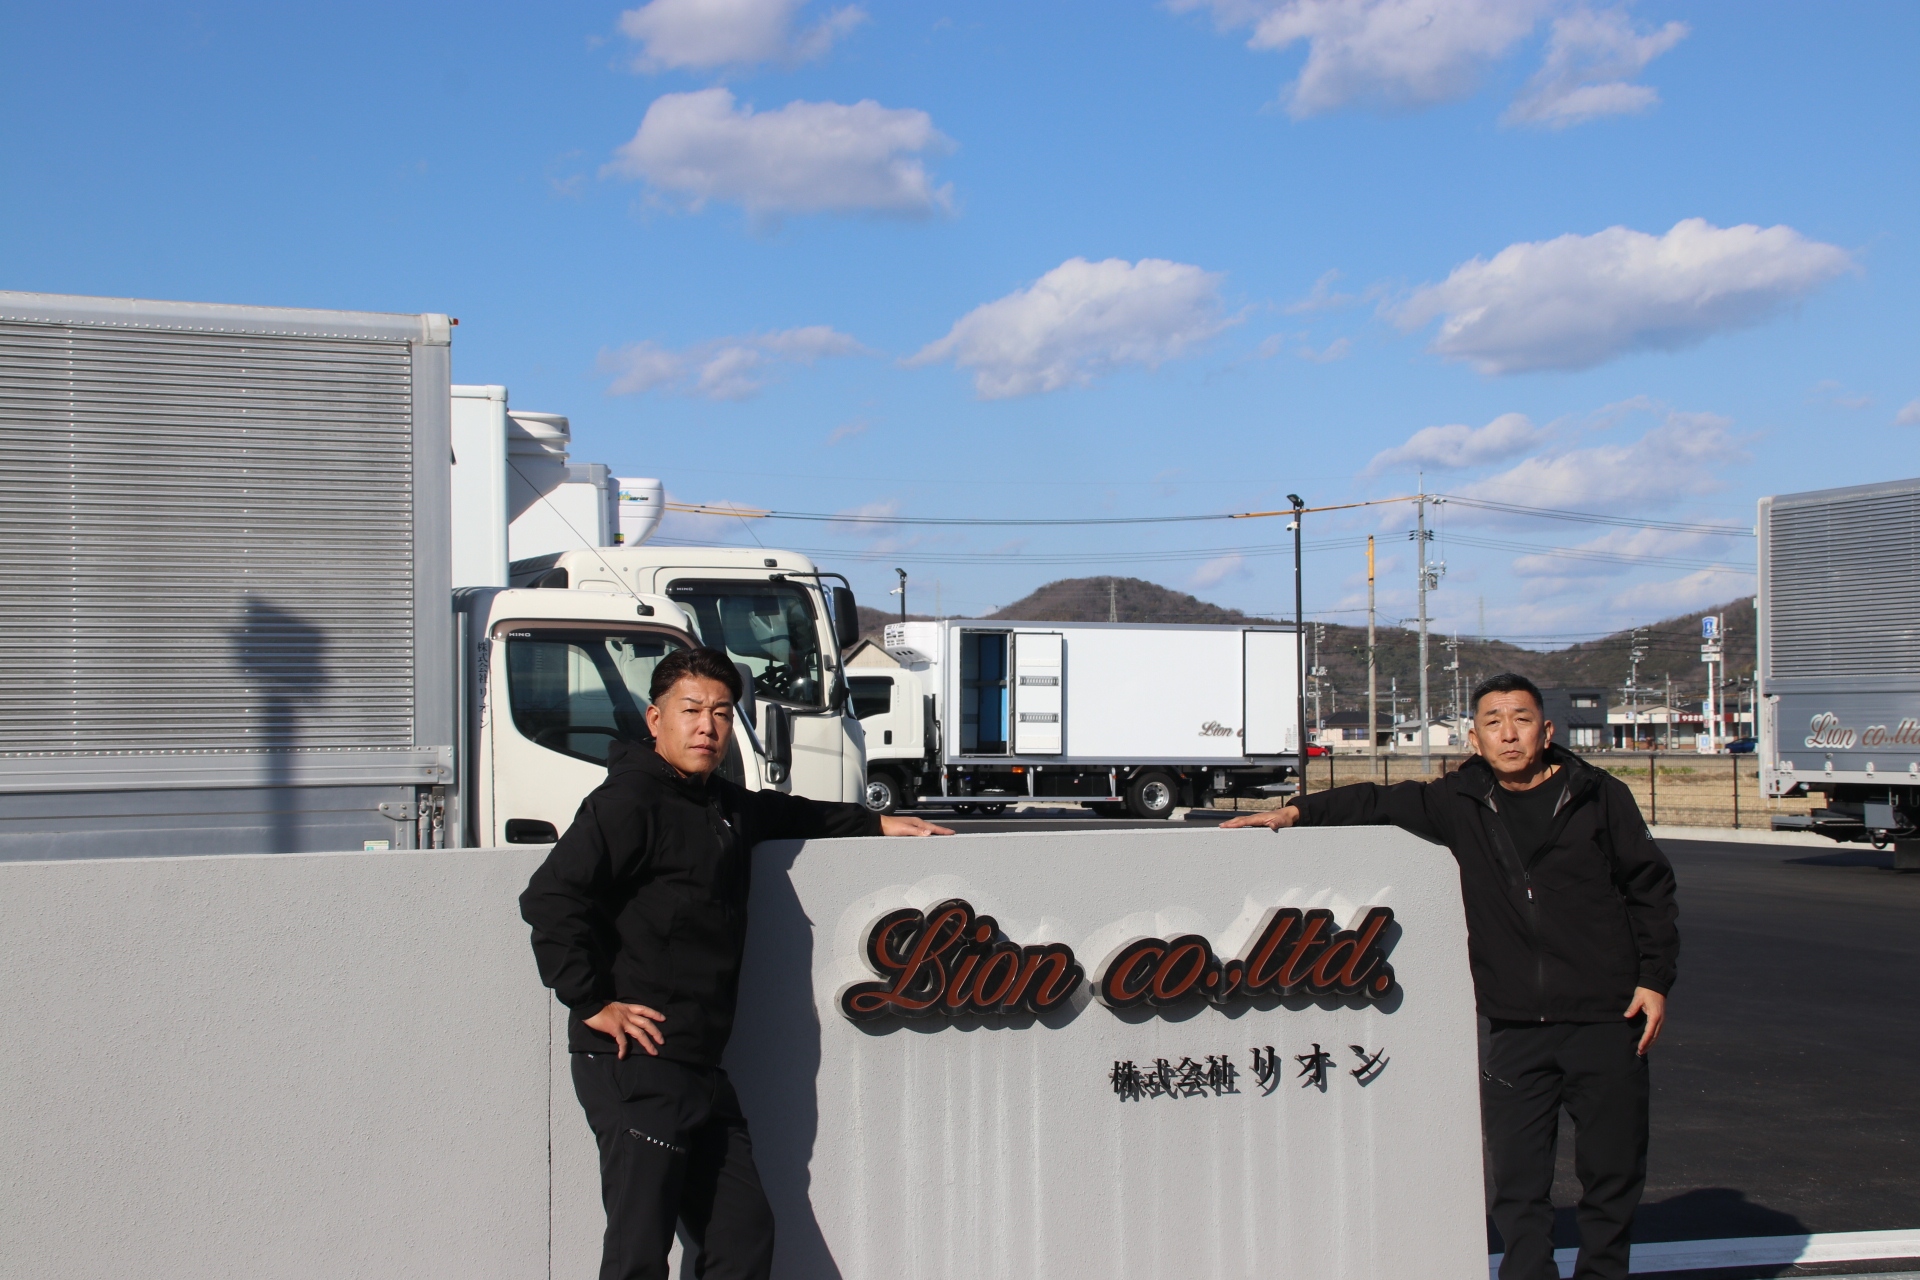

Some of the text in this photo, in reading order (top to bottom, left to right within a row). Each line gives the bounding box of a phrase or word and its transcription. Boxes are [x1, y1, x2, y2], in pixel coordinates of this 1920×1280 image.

[477, 641, 490, 729] 株式会社リオン
[1199, 721, 1234, 738] Lion
[1805, 712, 1857, 748] Lion
[845, 902, 1392, 1015] Lion co.,ltd.
[1110, 1043, 1386, 1094] 株式会社リオン
